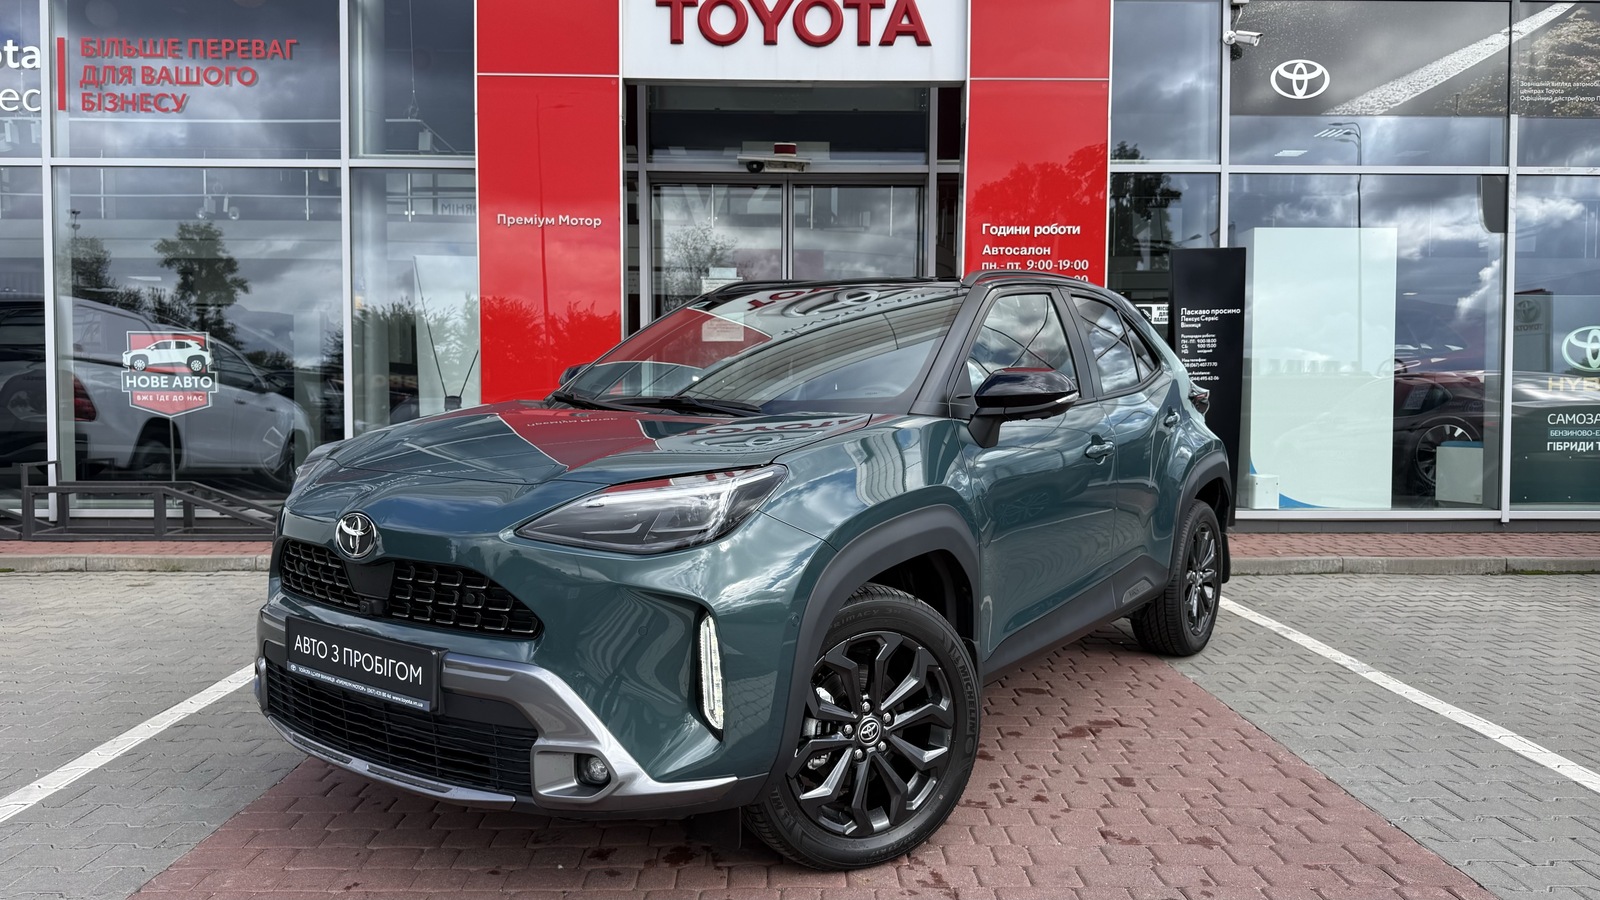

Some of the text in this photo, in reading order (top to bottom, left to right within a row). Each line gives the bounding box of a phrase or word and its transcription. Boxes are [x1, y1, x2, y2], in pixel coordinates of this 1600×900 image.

[656, 0, 932, 47] TOYOTA
[0, 40, 41, 69] ta
[79, 37, 298, 60] БІЛЬШЕ ПЕРЕВАГ
[79, 65, 258, 88] ДЛЯ ВАШОГО
[80, 92, 188, 113] БІЗНЕСУ
[496, 213, 602, 228] Преміум Мотор
[981, 222, 1081, 238] Години роботи
[981, 244, 1051, 256] Автосалон
[1026, 259, 1089, 271] 9:00-19:00
[1181, 307, 1241, 316] Ласкаво просимо
[126, 375, 213, 389] НОВЕ АВТО
[156, 393, 170, 402] ЇДЕ
[172, 394, 184, 402] ДО
[1547, 413, 1600, 425] САМОЗА
[1547, 441, 1594, 452] ГІБРИДИ
[294, 634, 328, 659] АВТО
[343, 647, 423, 686] ПРОБІГОМ
